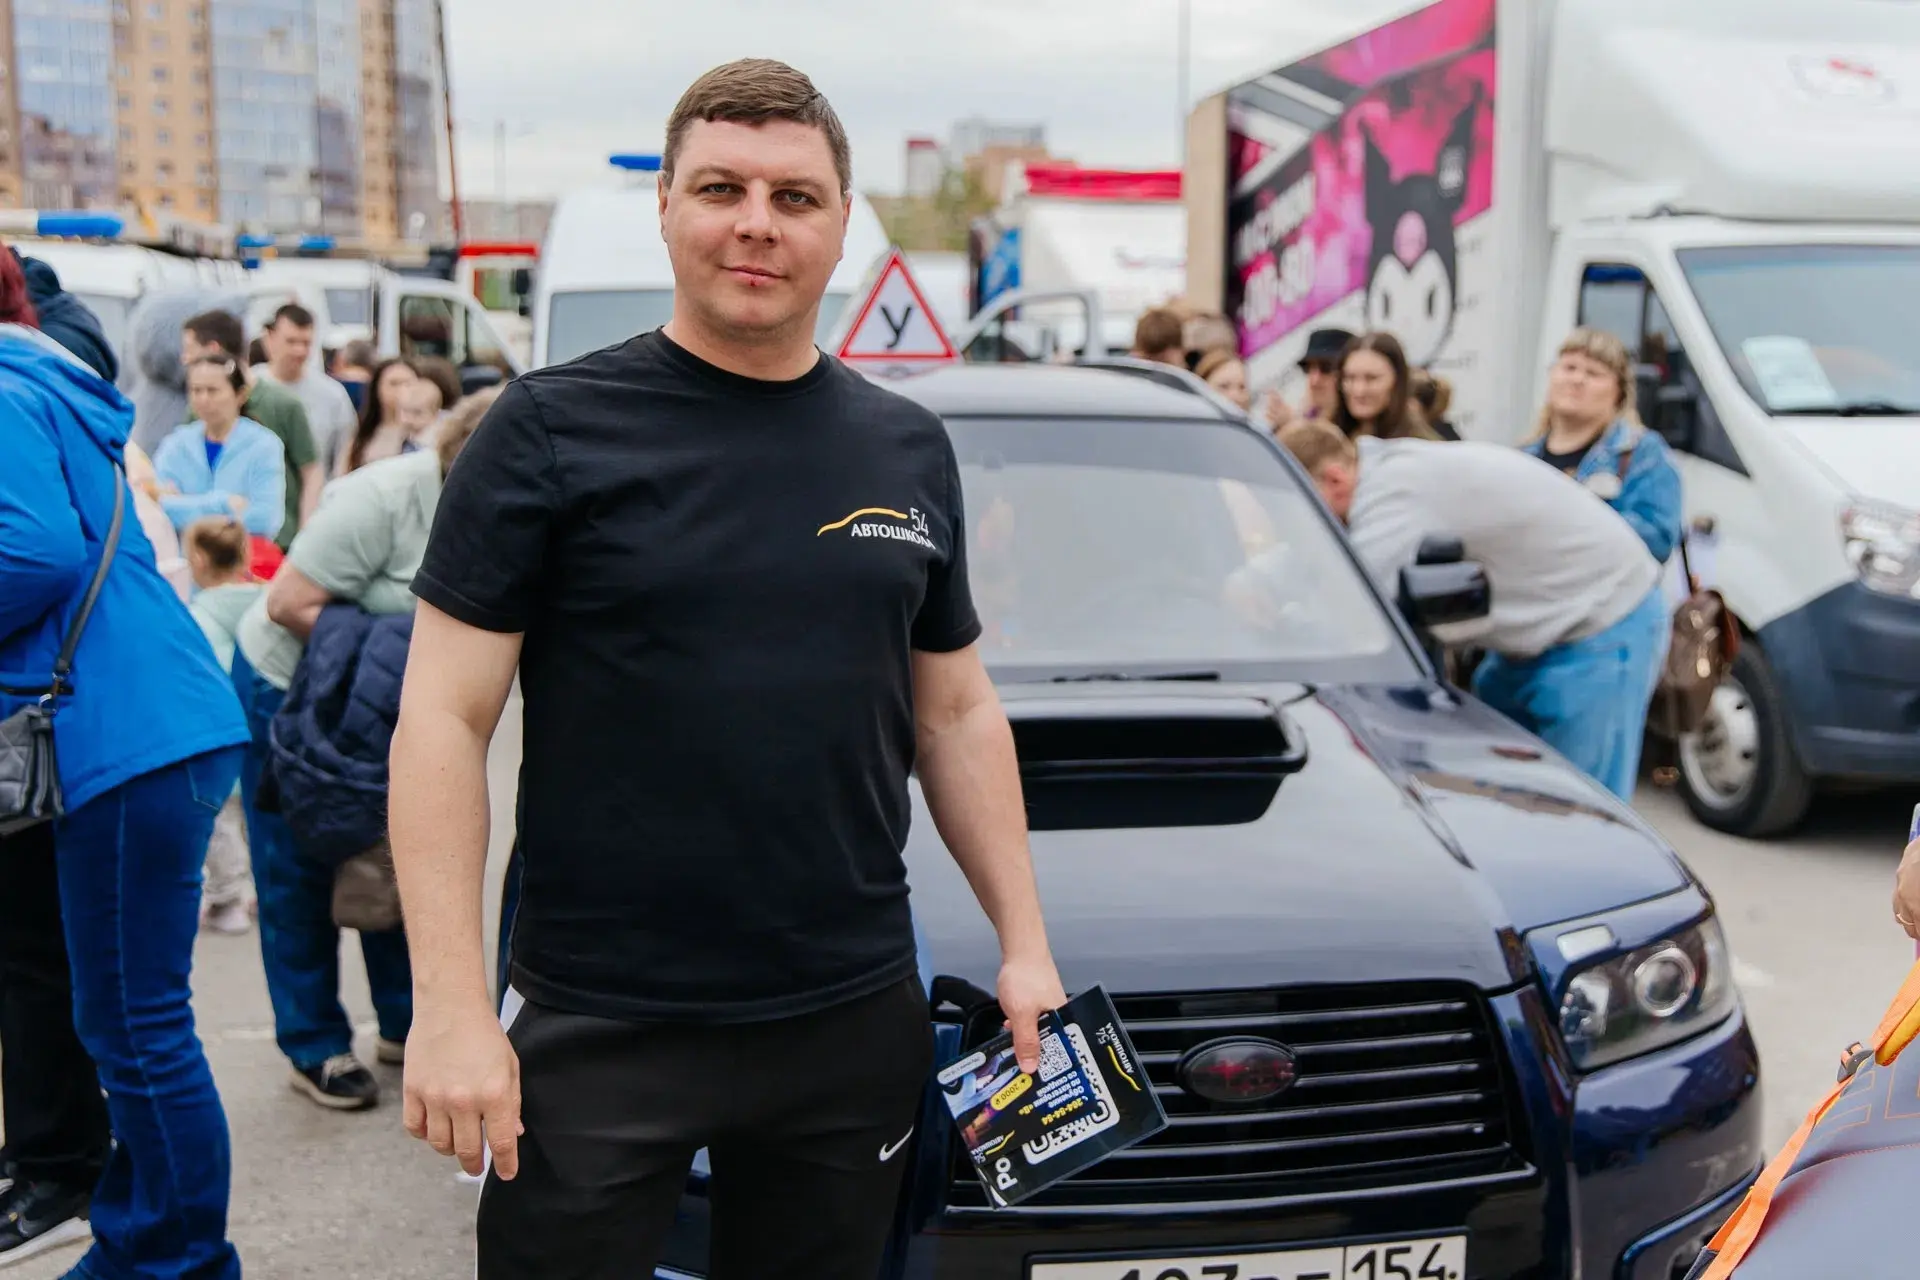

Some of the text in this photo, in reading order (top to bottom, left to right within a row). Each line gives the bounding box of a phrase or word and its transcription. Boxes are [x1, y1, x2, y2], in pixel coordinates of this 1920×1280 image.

[881, 305, 911, 349] У
[909, 506, 928, 536] 54
[1095, 1027, 1110, 1044] 54
[1105, 1023, 1134, 1073] АВТОШКОЛА
[1033, 1080, 1072, 1107] категории
[1036, 1075, 1069, 1097] скидкой
[1046, 1084, 1085, 1108] Обучение
